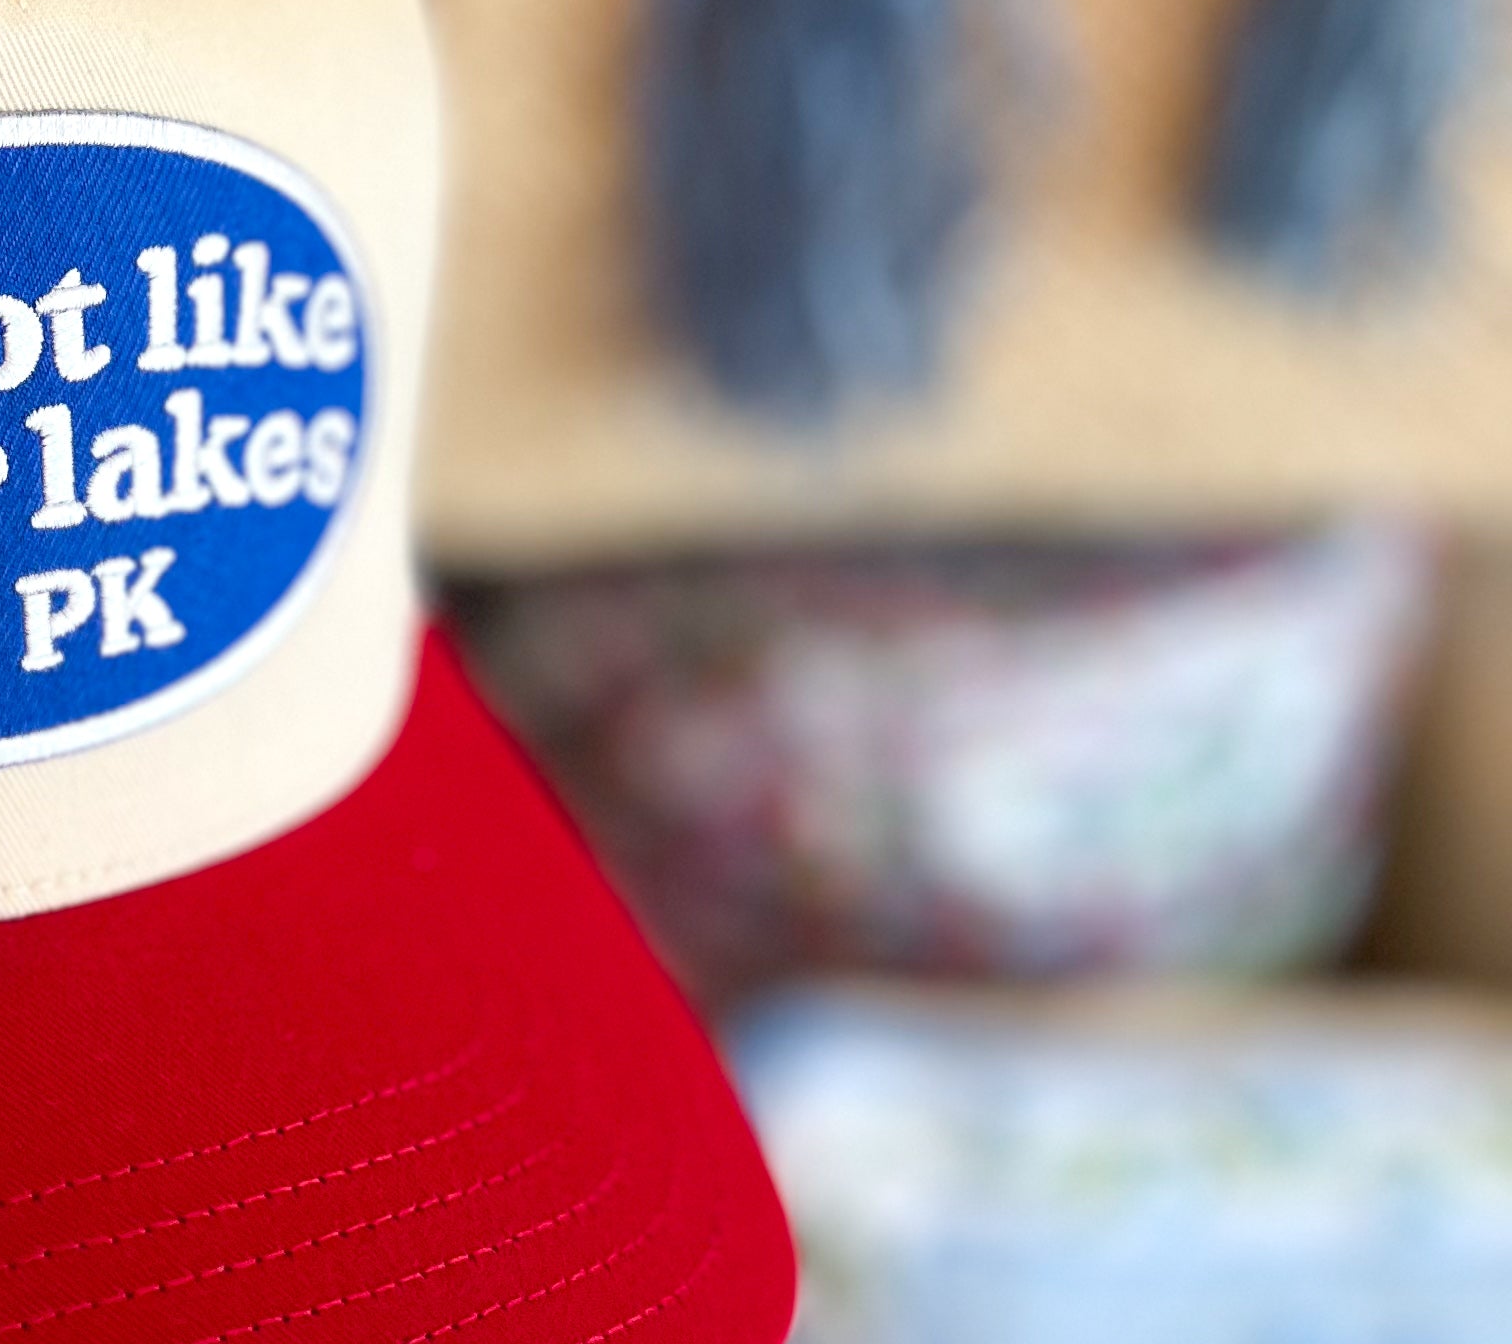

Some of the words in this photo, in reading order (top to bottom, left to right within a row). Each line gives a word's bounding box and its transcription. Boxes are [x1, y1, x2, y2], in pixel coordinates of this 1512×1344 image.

[137, 232, 356, 373] like
[26, 388, 357, 531] lakes
[14, 547, 186, 672] PK
